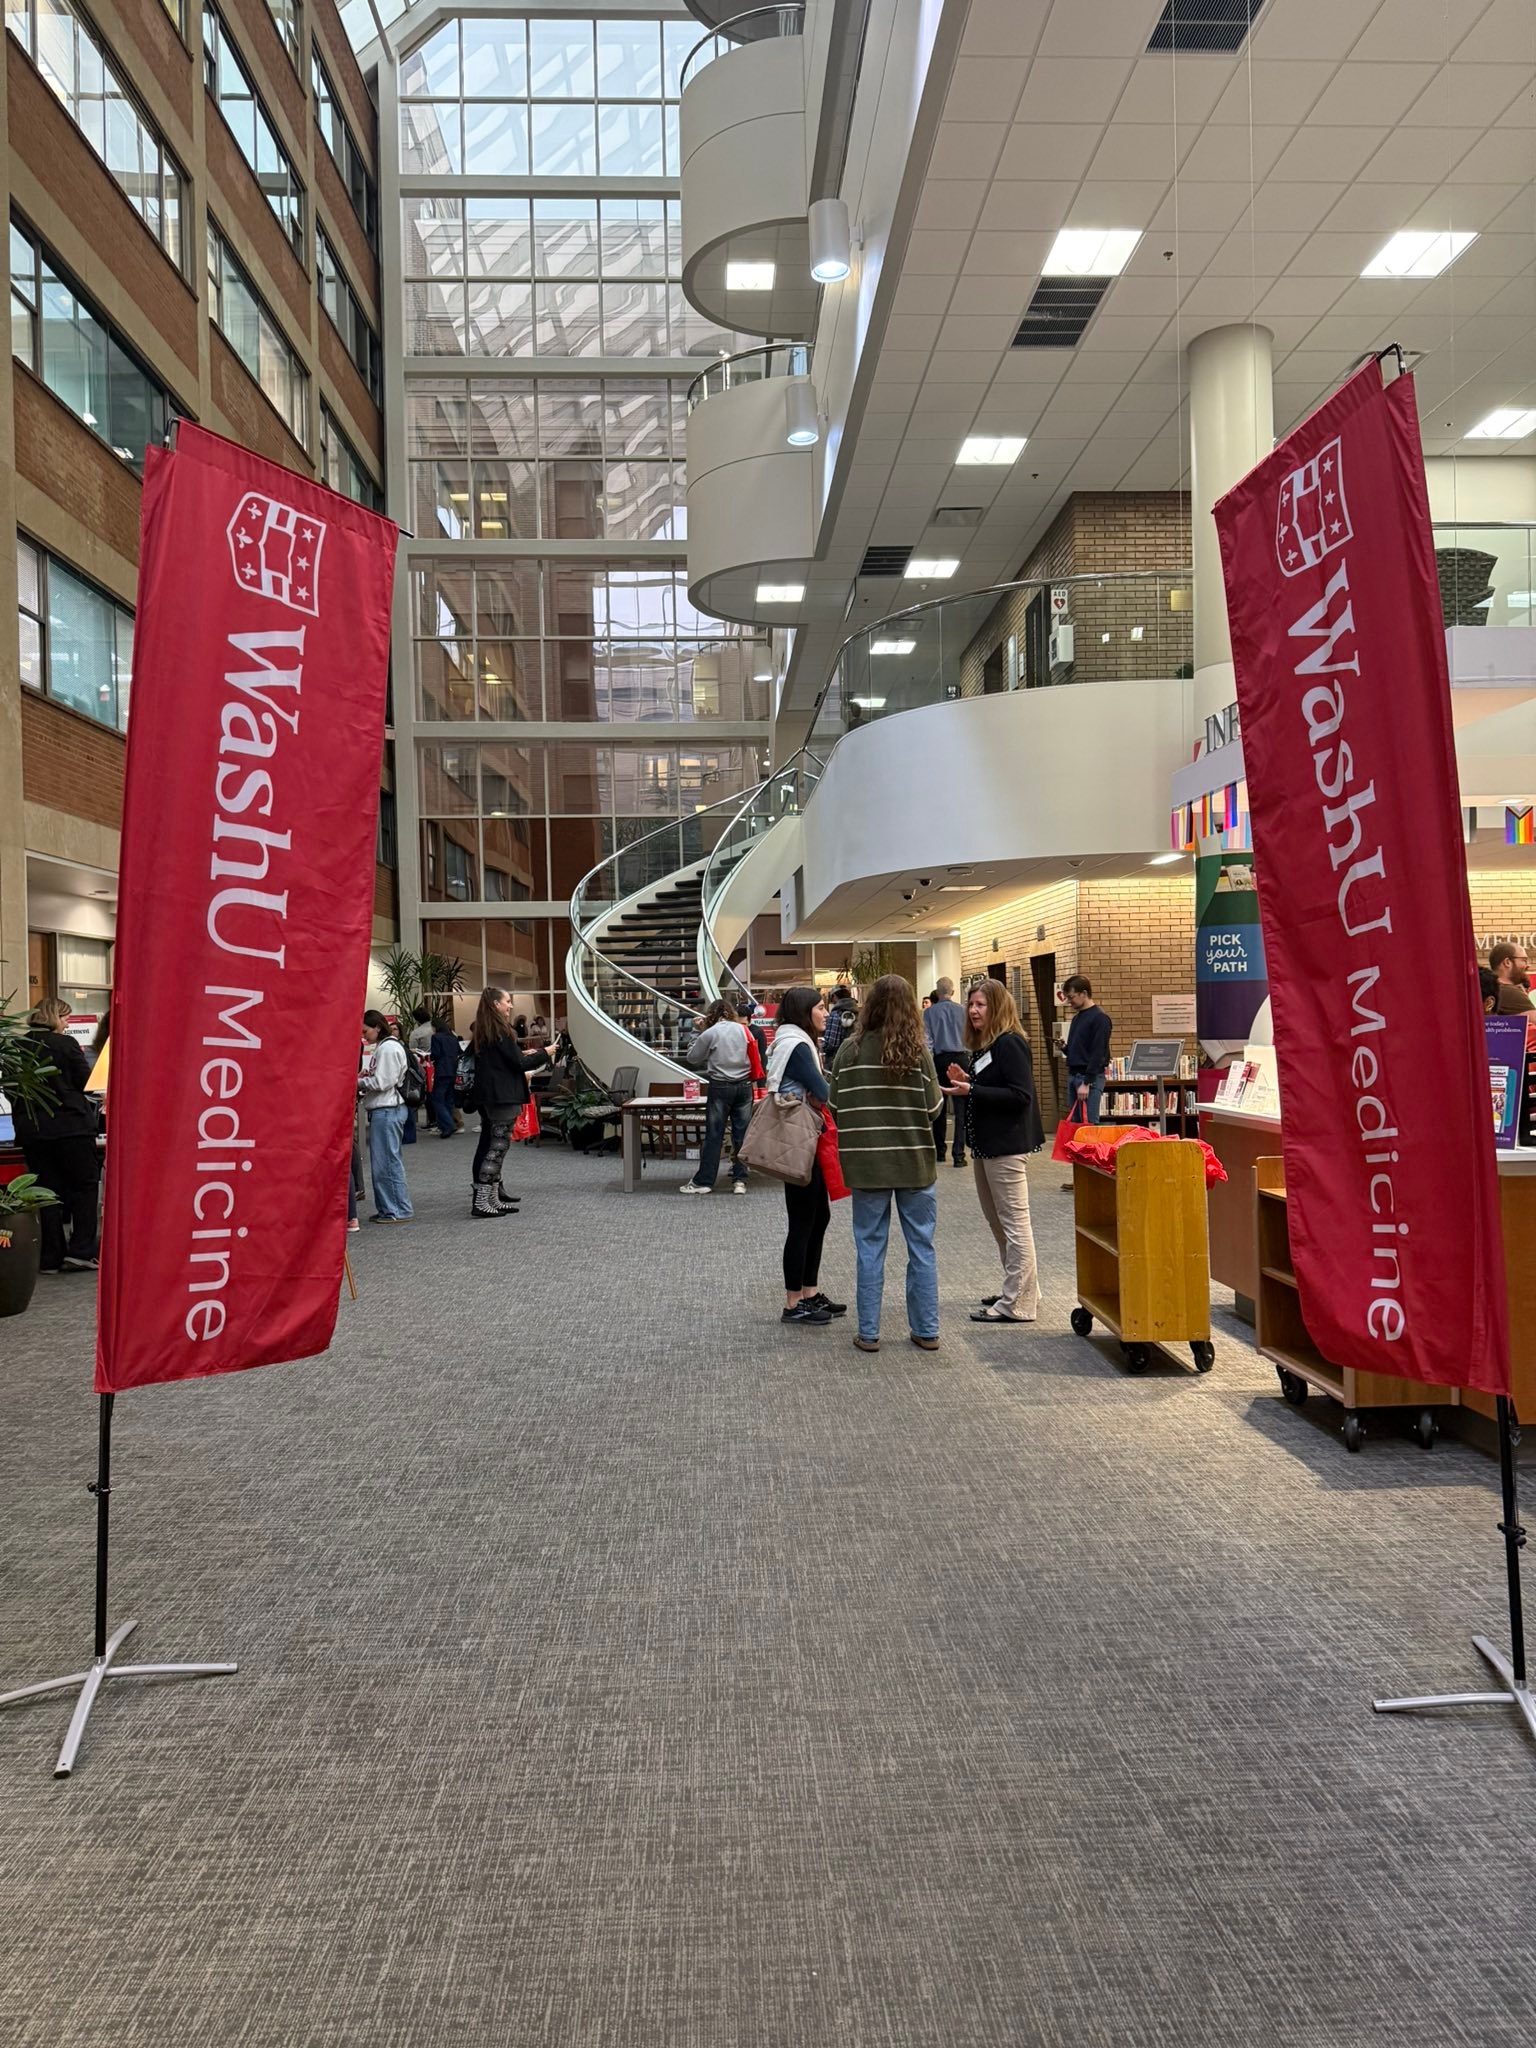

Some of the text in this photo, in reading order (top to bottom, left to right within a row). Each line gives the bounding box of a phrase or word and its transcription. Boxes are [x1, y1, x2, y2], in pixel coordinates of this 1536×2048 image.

[1210, 933, 1241, 946] PICK
[1287, 556, 1410, 1343] WashU Medicine
[1206, 945, 1248, 965] your
[1213, 961, 1248, 973] PATH
[185, 624, 306, 1342] WashU Medicine
